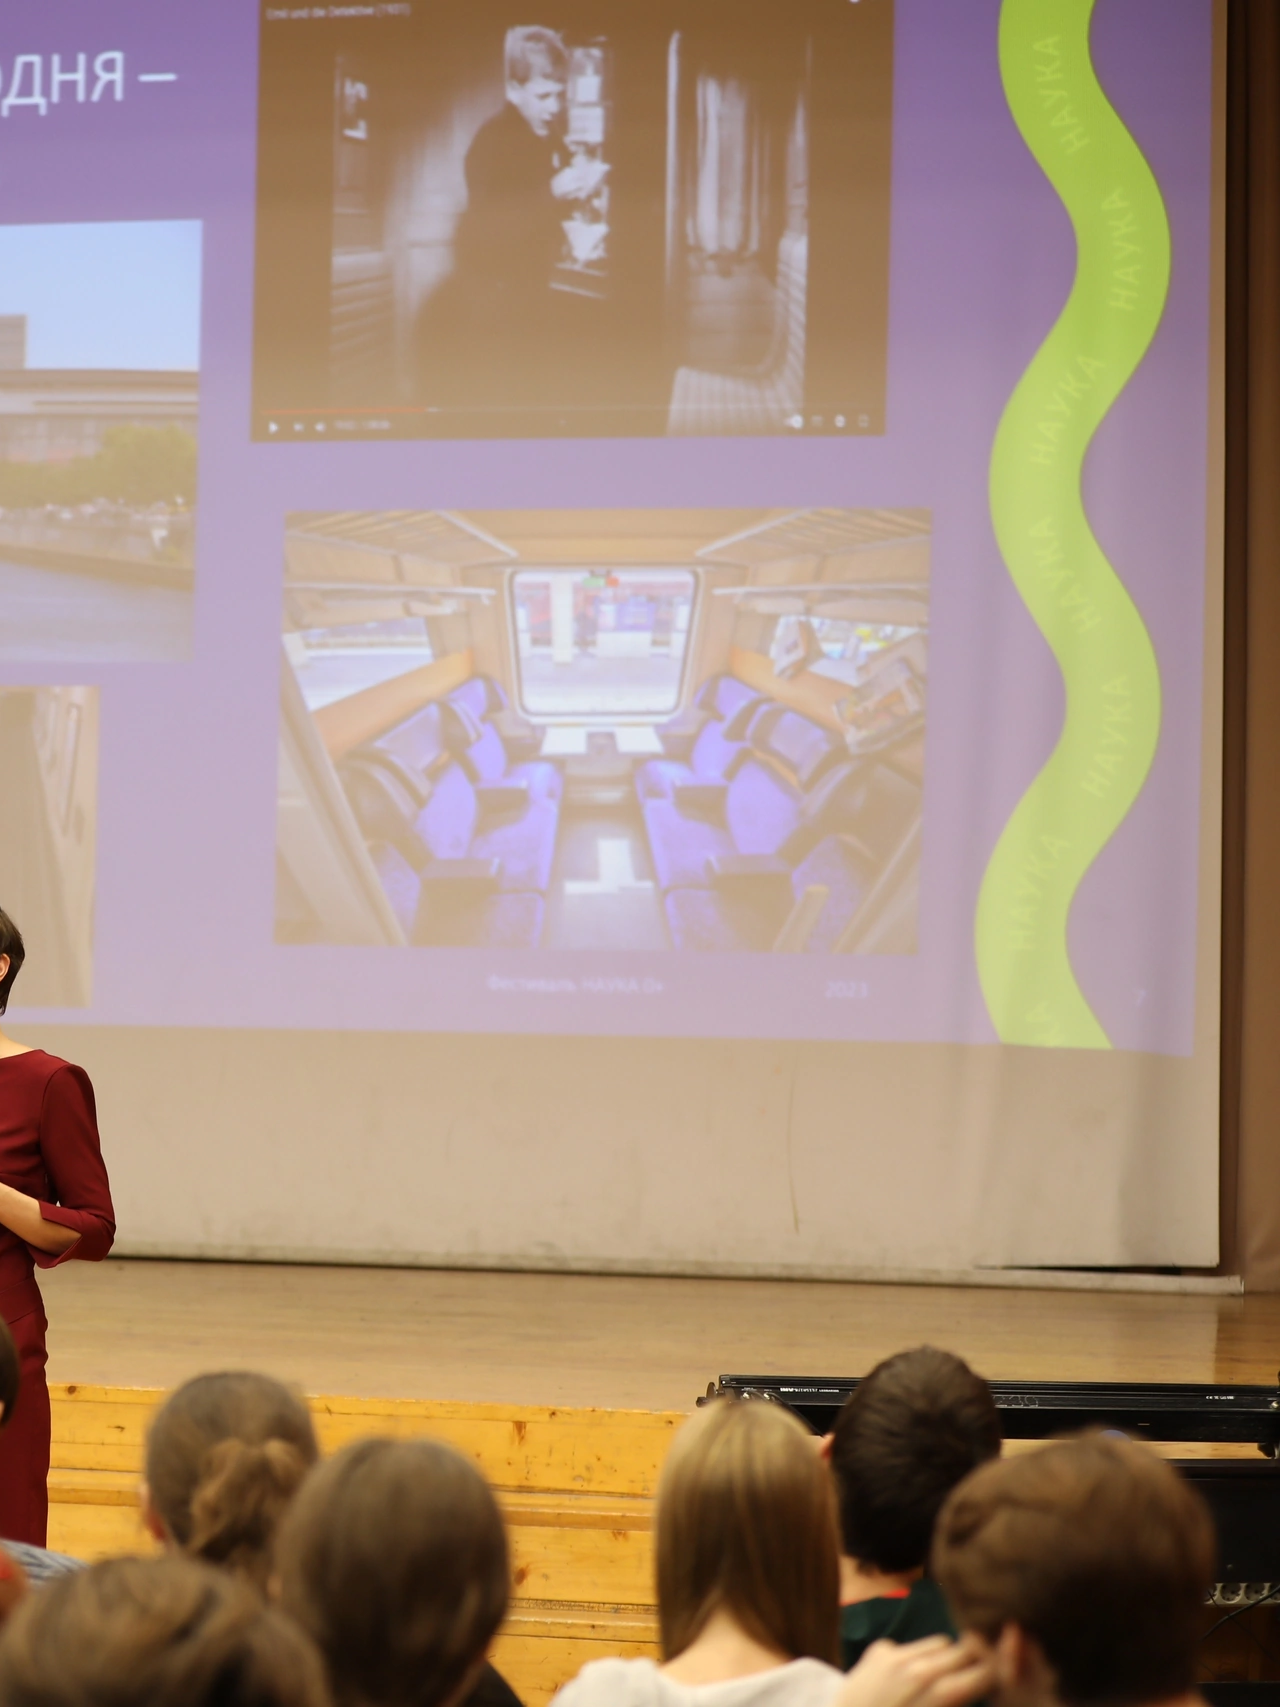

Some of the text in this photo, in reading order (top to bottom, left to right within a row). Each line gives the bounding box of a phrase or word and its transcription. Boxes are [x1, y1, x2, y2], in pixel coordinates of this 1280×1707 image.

[1032, 34, 1091, 156] НАУКА
[1100, 187, 1144, 312] НАУКА
[1030, 353, 1107, 466] НАУКА
[1029, 516, 1103, 635] НАУКА
[1080, 675, 1131, 798] НАУКА
[1010, 833, 1072, 951] НАУКА
